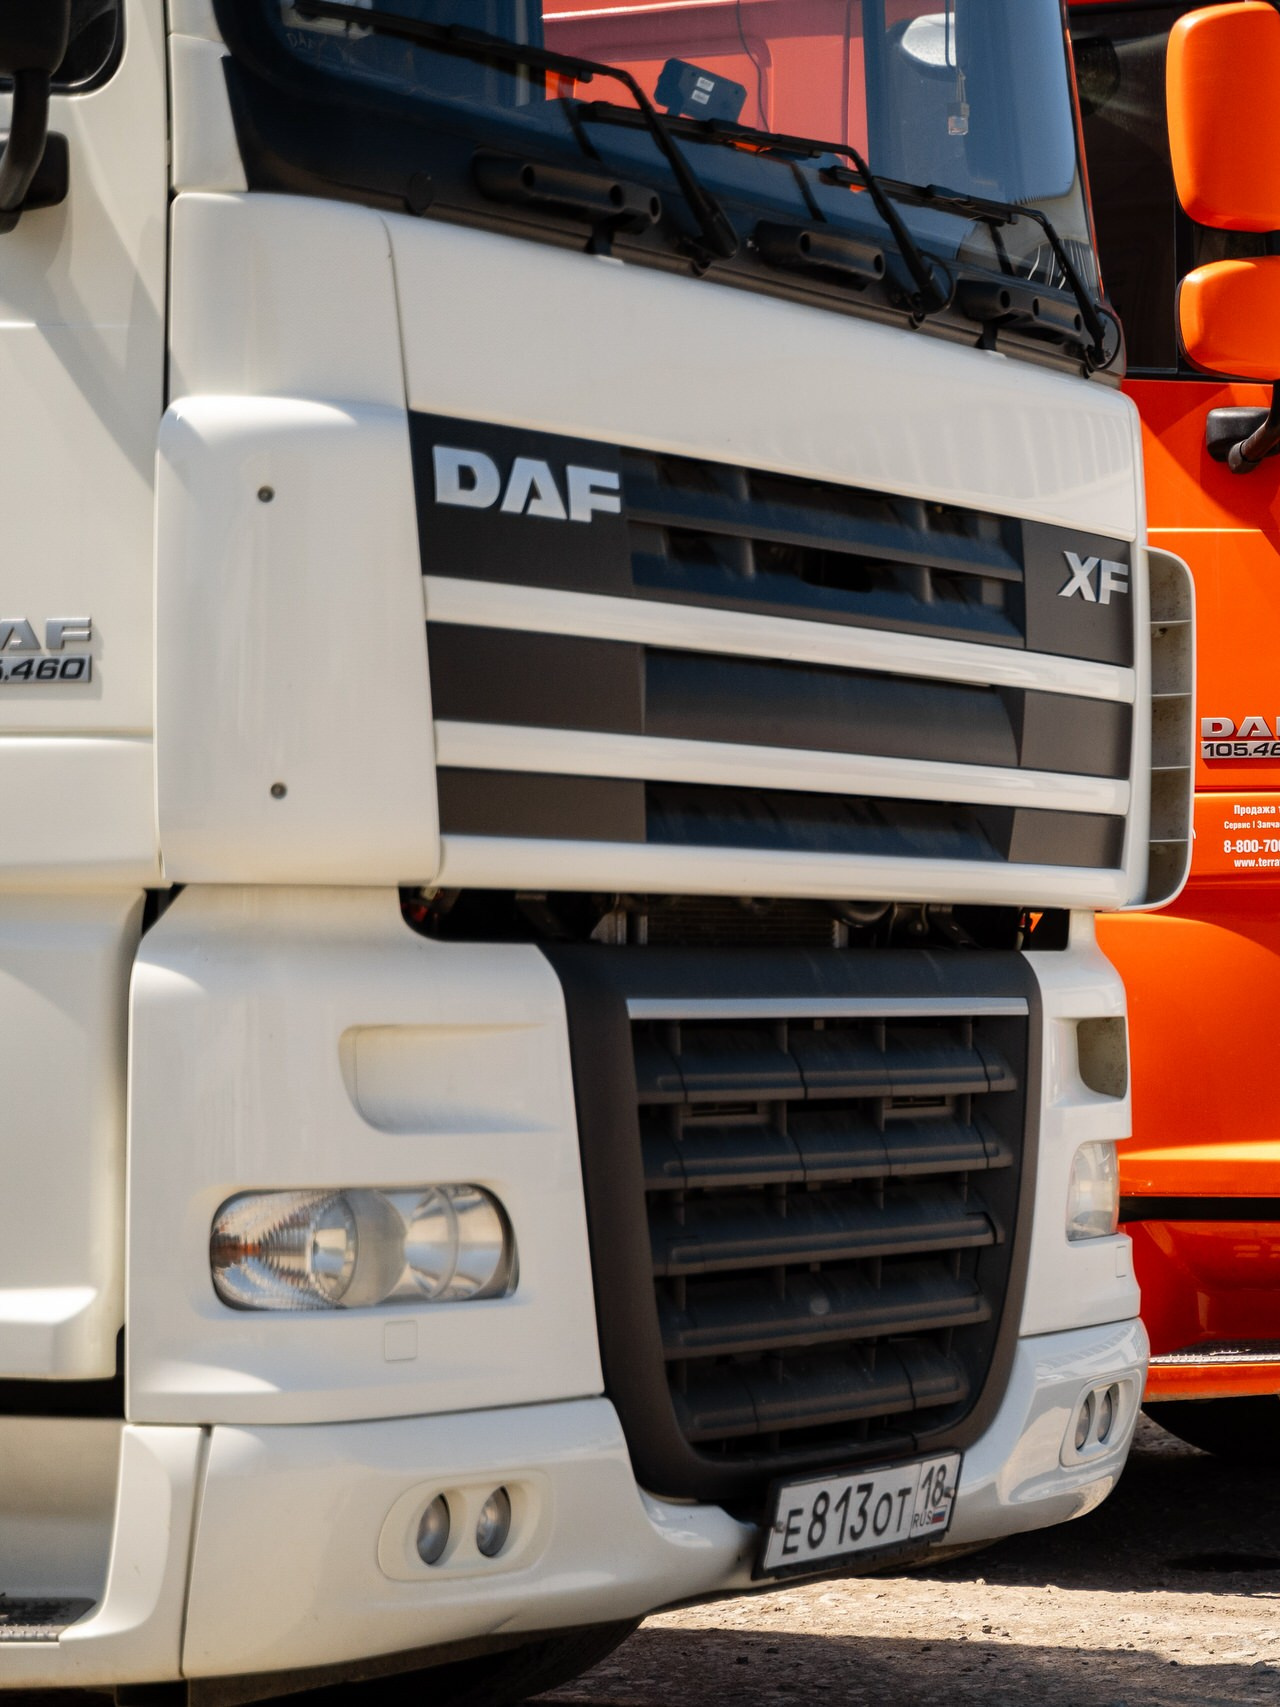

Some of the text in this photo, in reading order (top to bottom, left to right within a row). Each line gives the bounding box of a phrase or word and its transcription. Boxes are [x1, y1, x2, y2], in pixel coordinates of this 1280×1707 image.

[432, 445, 622, 523] DAF
[1057, 550, 1129, 605] XF
[0, 658, 86, 680] .460
[1234, 805, 1275, 815] Продажа
[1224, 821, 1250, 829] Сервис
[921, 1464, 947, 1510] 18
[912, 1510, 933, 1528] RUS
